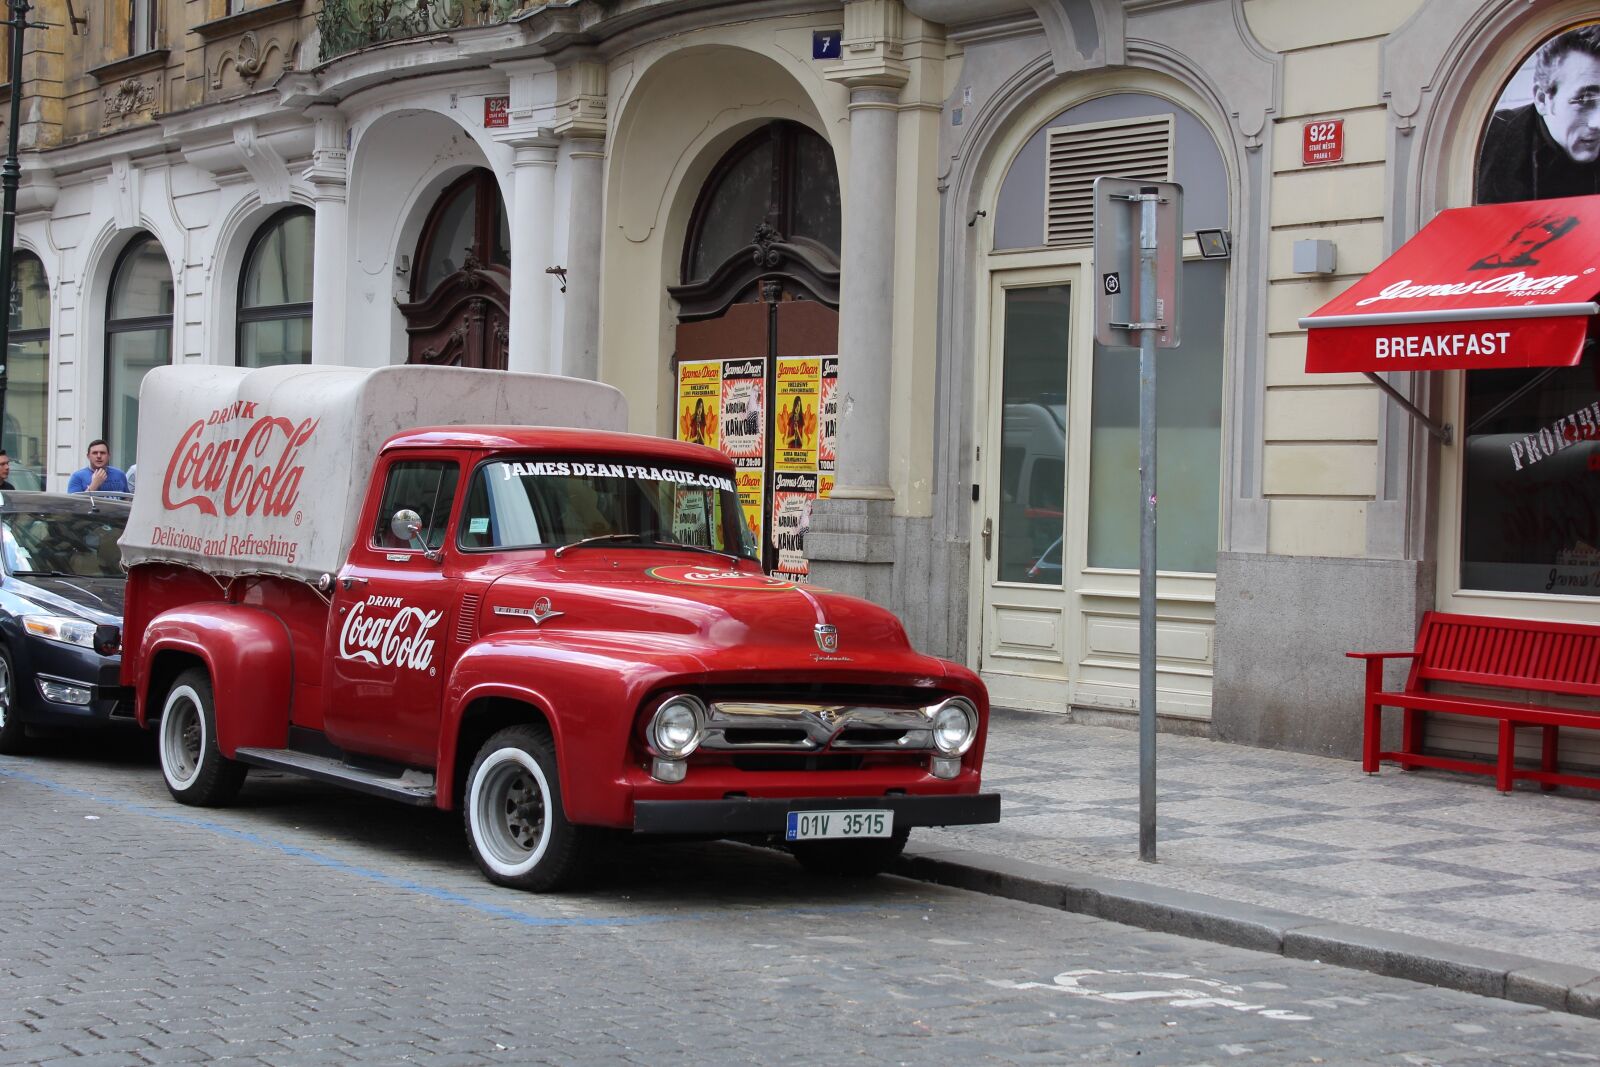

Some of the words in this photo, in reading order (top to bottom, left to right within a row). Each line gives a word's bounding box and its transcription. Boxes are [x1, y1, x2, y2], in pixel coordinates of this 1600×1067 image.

[822, 37, 831, 53] 7
[490, 100, 508, 111] 923
[1310, 123, 1336, 142] 922
[1356, 279, 1473, 306] James
[1472, 271, 1579, 296] Dean
[1506, 288, 1561, 298] PRAGUE
[1376, 332, 1511, 358] BREAKFAST
[681, 366, 702, 382] James
[701, 365, 719, 378] Dean
[723, 362, 744, 378] James
[744, 361, 762, 374] Dean
[777, 361, 799, 378] James
[799, 361, 818, 375] Dean
[207, 400, 259, 426] DRINK
[162, 415, 321, 517] Coca-Cola
[738, 457, 745, 467] AT
[745, 457, 761, 467] 20:00
[819, 460, 834, 470] TODA
[741, 473, 760, 487] Dean
[776, 473, 797, 490] James
[797, 474, 815, 488] Dean
[151, 527, 203, 551] Delicious
[204, 533, 227, 557] and
[229, 535, 299, 563] Refreshing
[367, 594, 404, 608] DRINK
[498, 607, 530, 615] FORD
[339, 600, 444, 671] Coca-Cola
[800, 815, 830, 836] 01V
[842, 814, 885, 835] 3515
